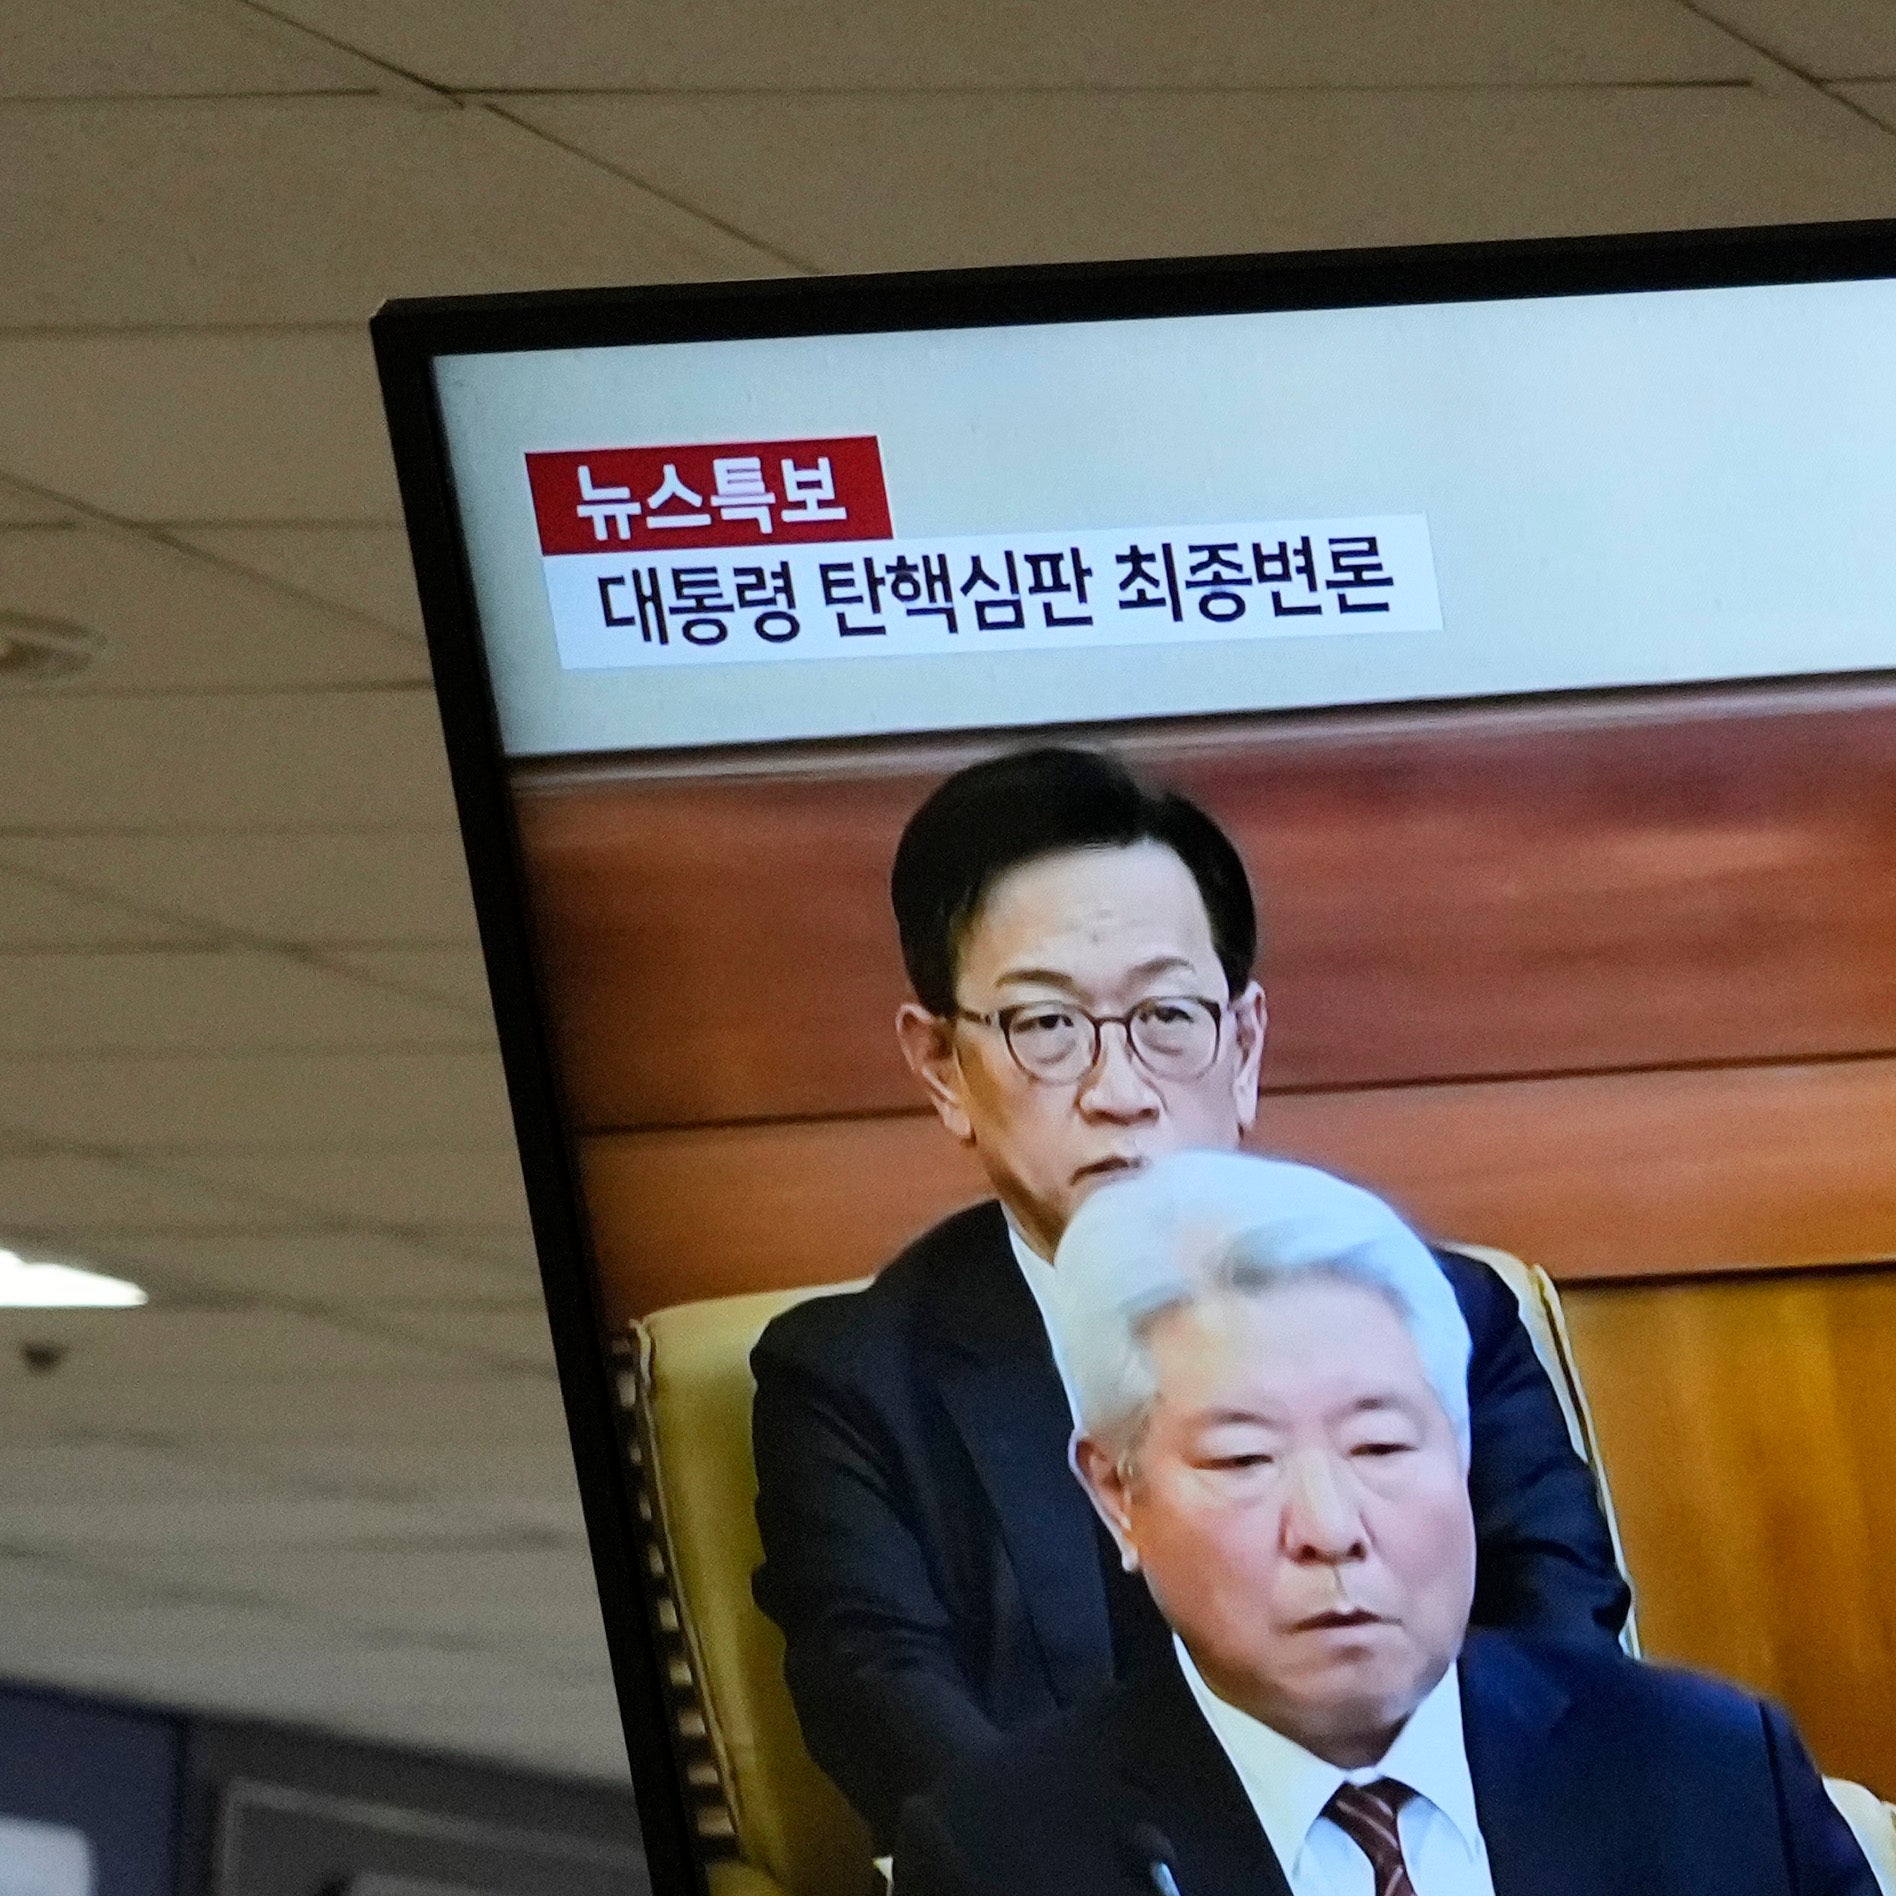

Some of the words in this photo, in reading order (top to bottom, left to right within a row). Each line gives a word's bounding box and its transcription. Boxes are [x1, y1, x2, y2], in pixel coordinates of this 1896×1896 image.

[575, 455, 849, 542] 뉴스특보
[597, 559, 802, 648] 대통령
[818, 545, 1095, 638] 탄핵심판
[1114, 534, 1395, 624] 최종변론
